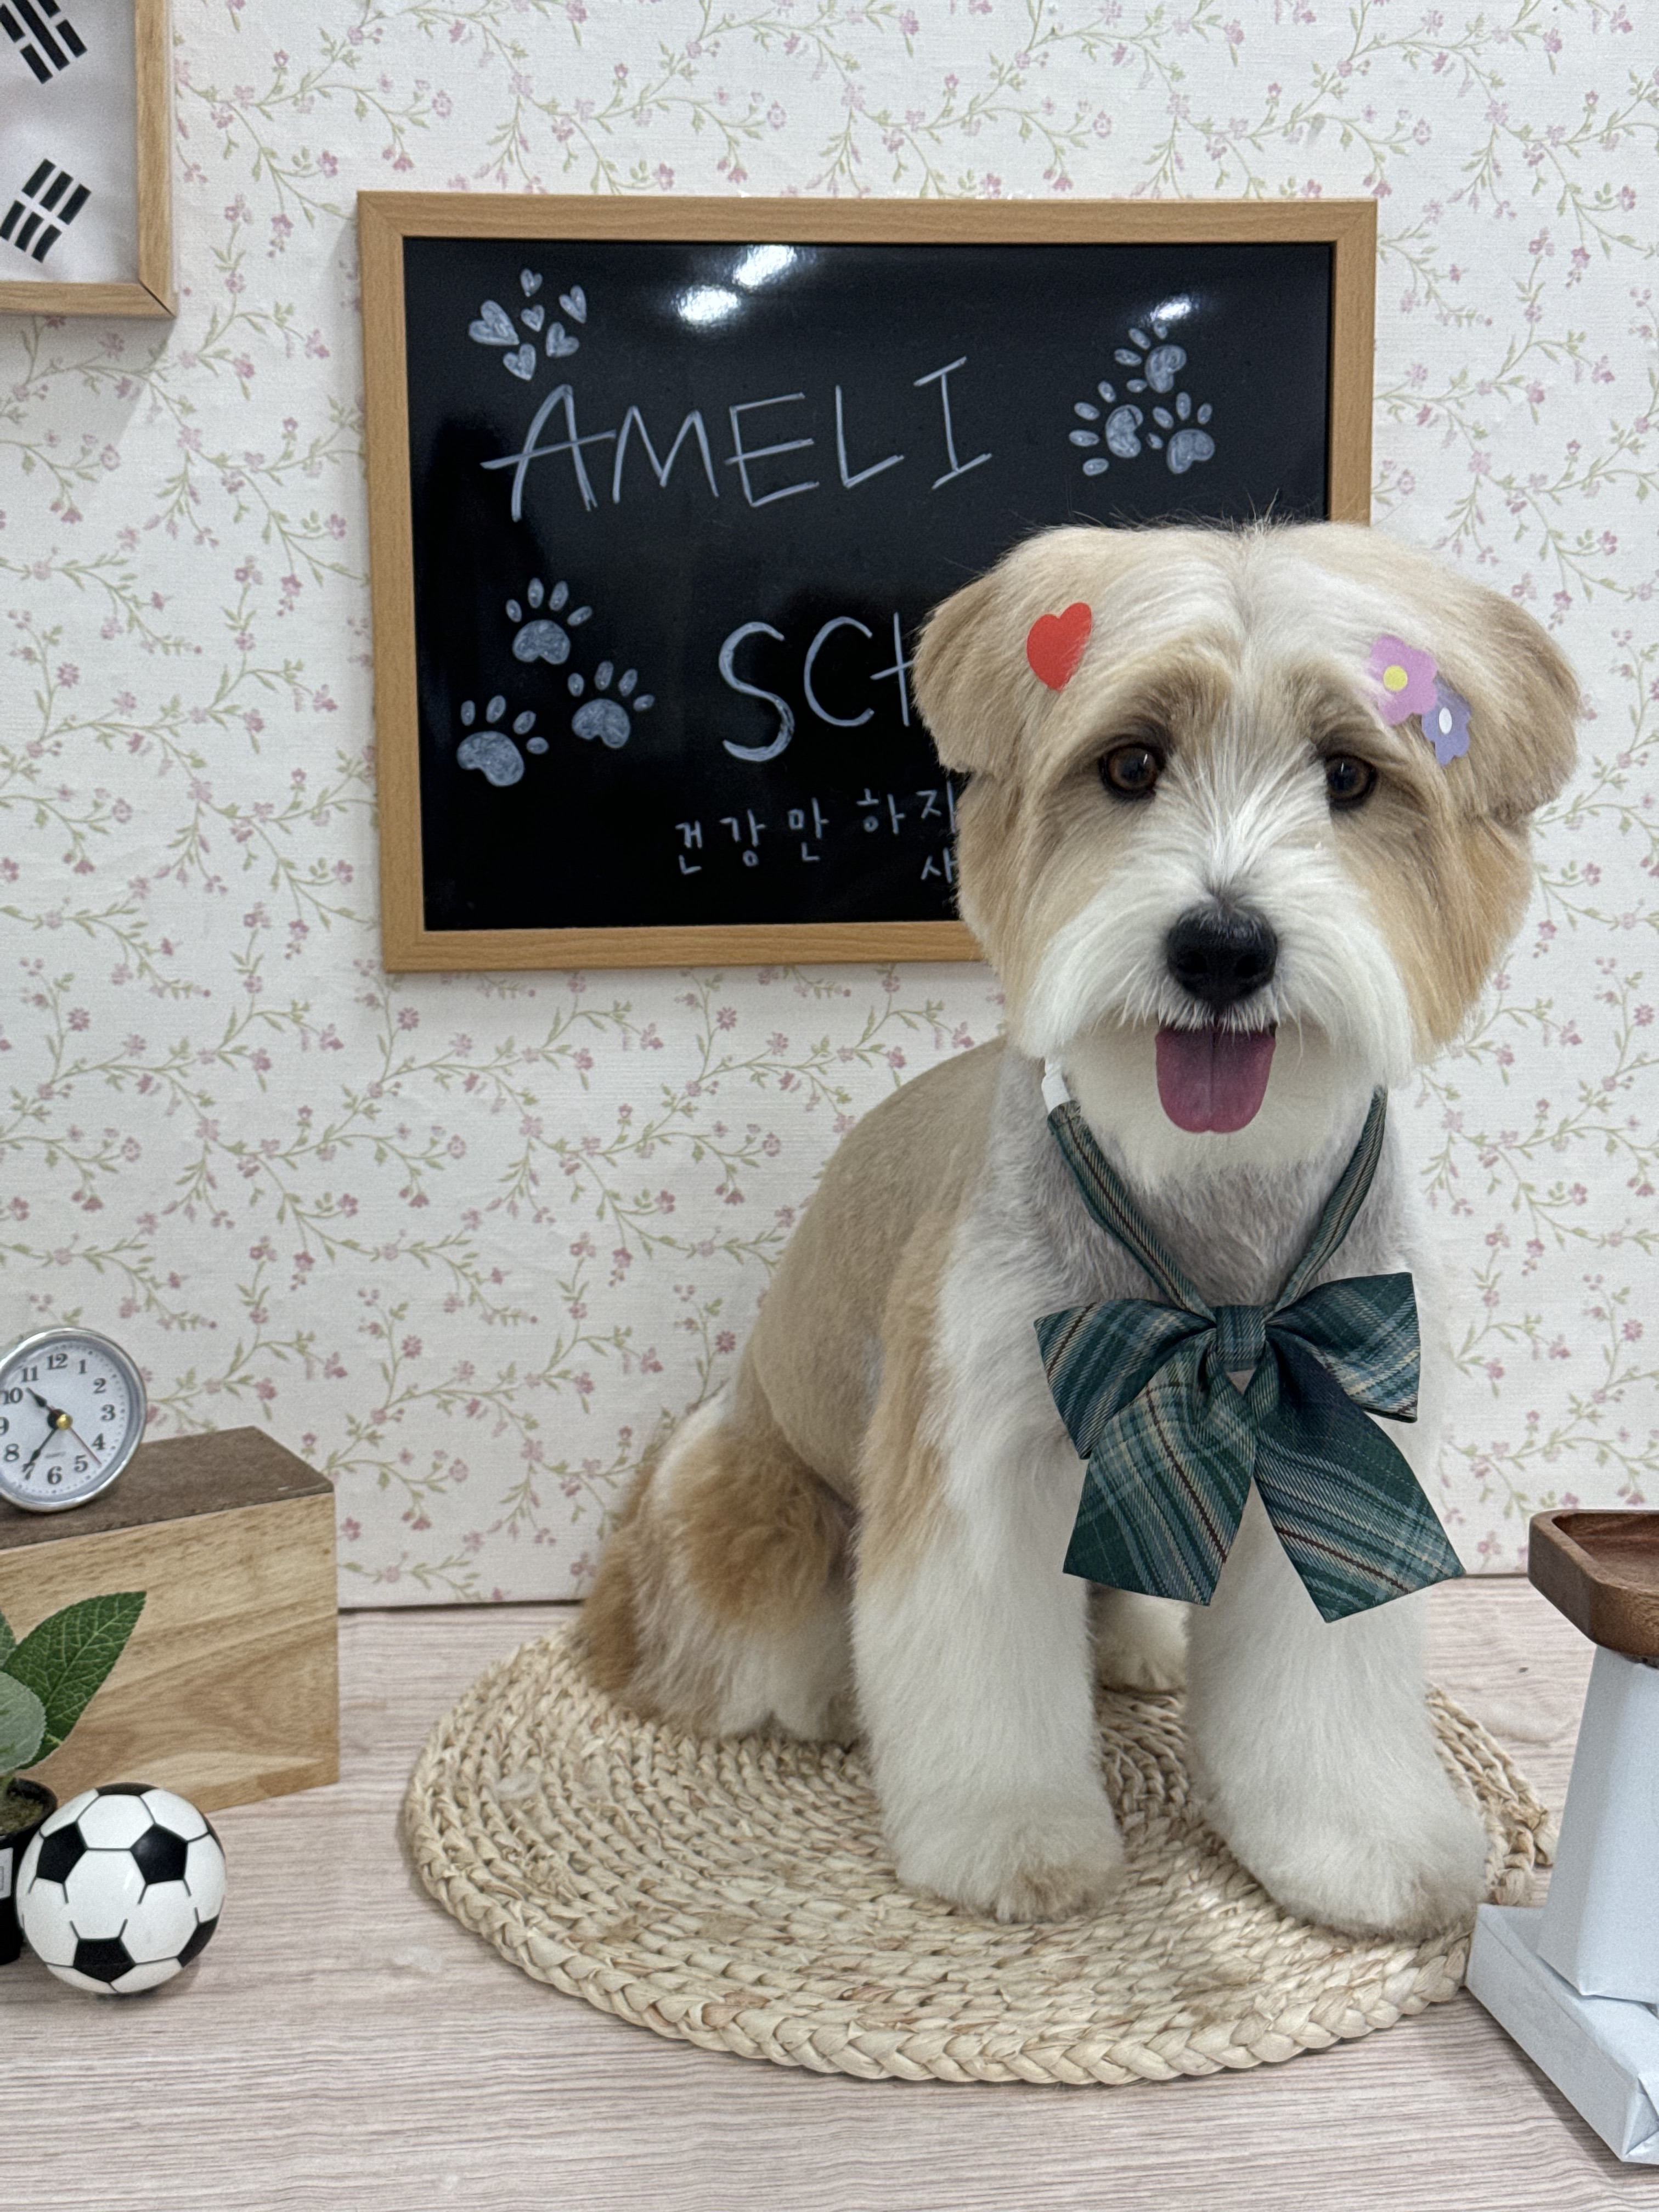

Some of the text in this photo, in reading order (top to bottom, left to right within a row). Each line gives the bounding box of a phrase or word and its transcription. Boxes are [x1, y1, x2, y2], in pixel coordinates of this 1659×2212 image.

[481, 357, 992, 522] AMELI
[47, 1353, 68, 1370] 12
[78, 1359, 86, 1374] 1
[21, 1365, 40, 1383] 11
[93, 1378, 106, 1393] 2
[0, 1386, 23, 1404] 10
[101, 1404, 115, 1421] 3
[92, 1433, 105, 1450] 4
[4, 1443, 20, 1462] 8
[74, 1454, 88, 1472] 5
[47, 1465, 62, 1485] 6
